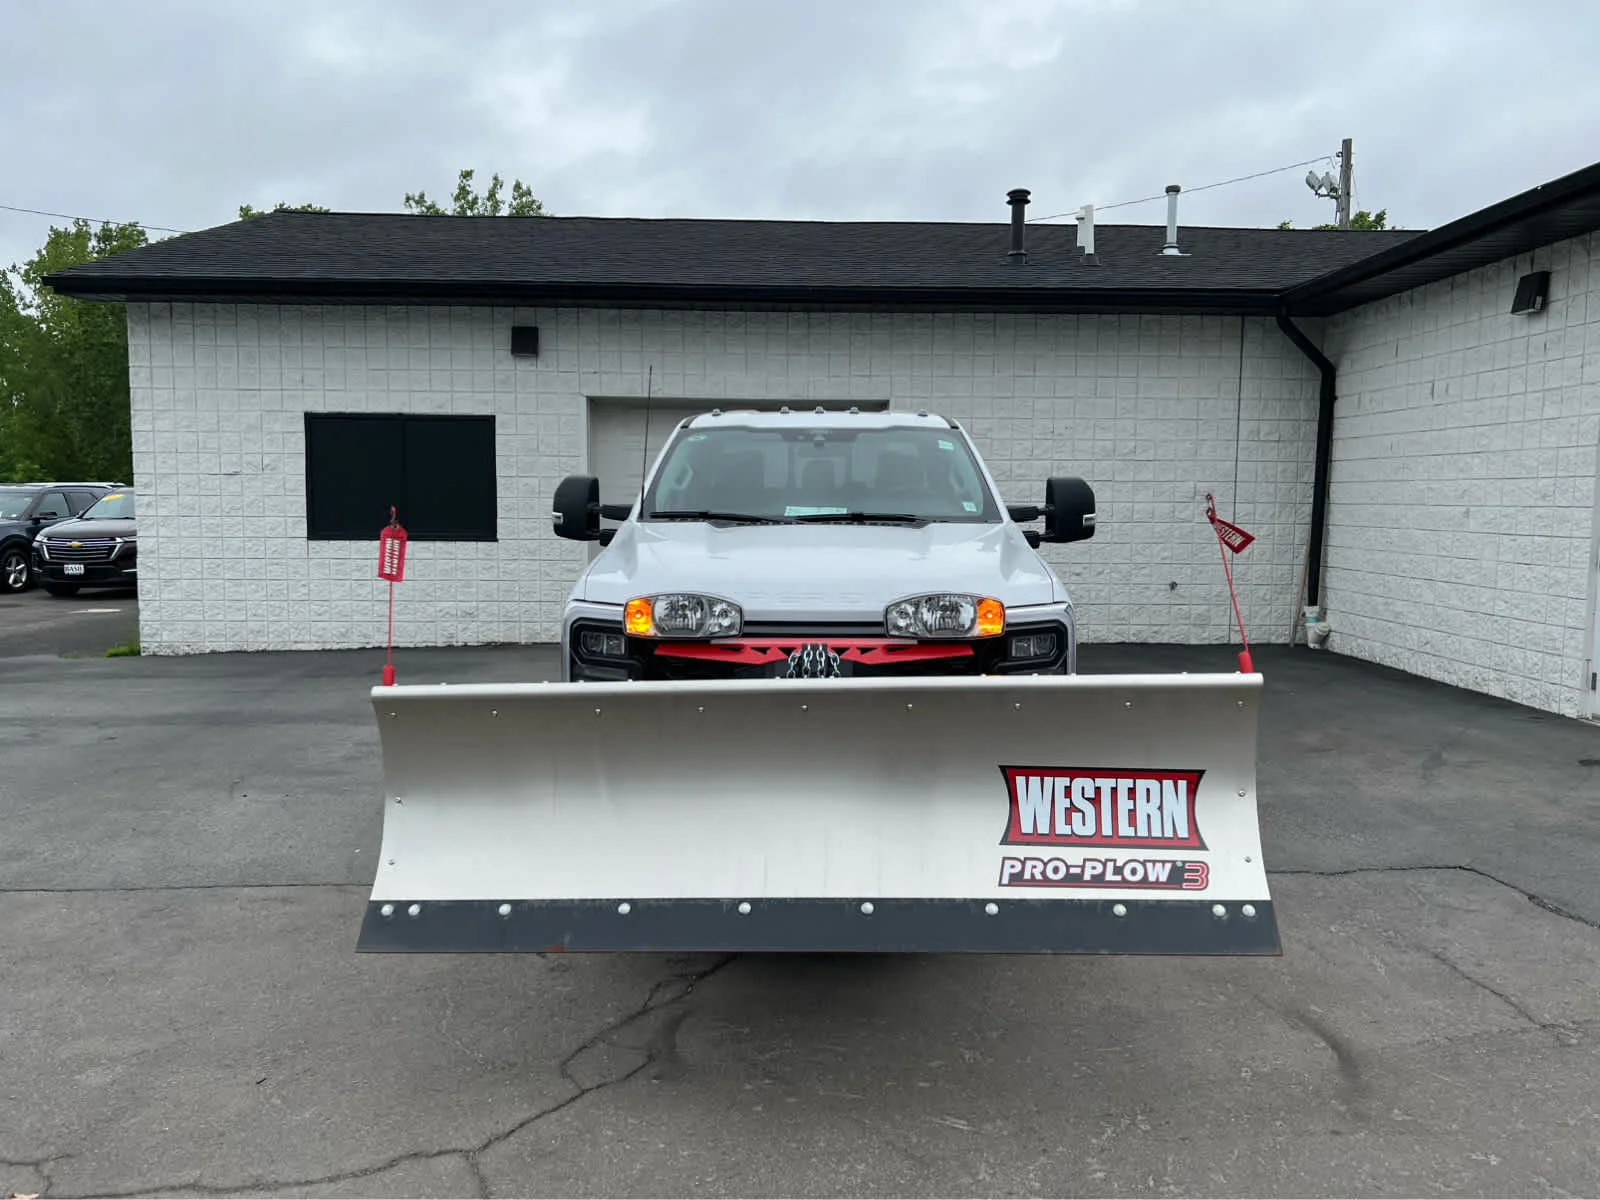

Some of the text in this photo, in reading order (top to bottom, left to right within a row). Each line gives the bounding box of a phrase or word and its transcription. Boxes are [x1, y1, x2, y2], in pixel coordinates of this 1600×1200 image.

[1015, 775, 1190, 839] WESTERN
[1000, 858, 1208, 890] PRO-PLOW 3
